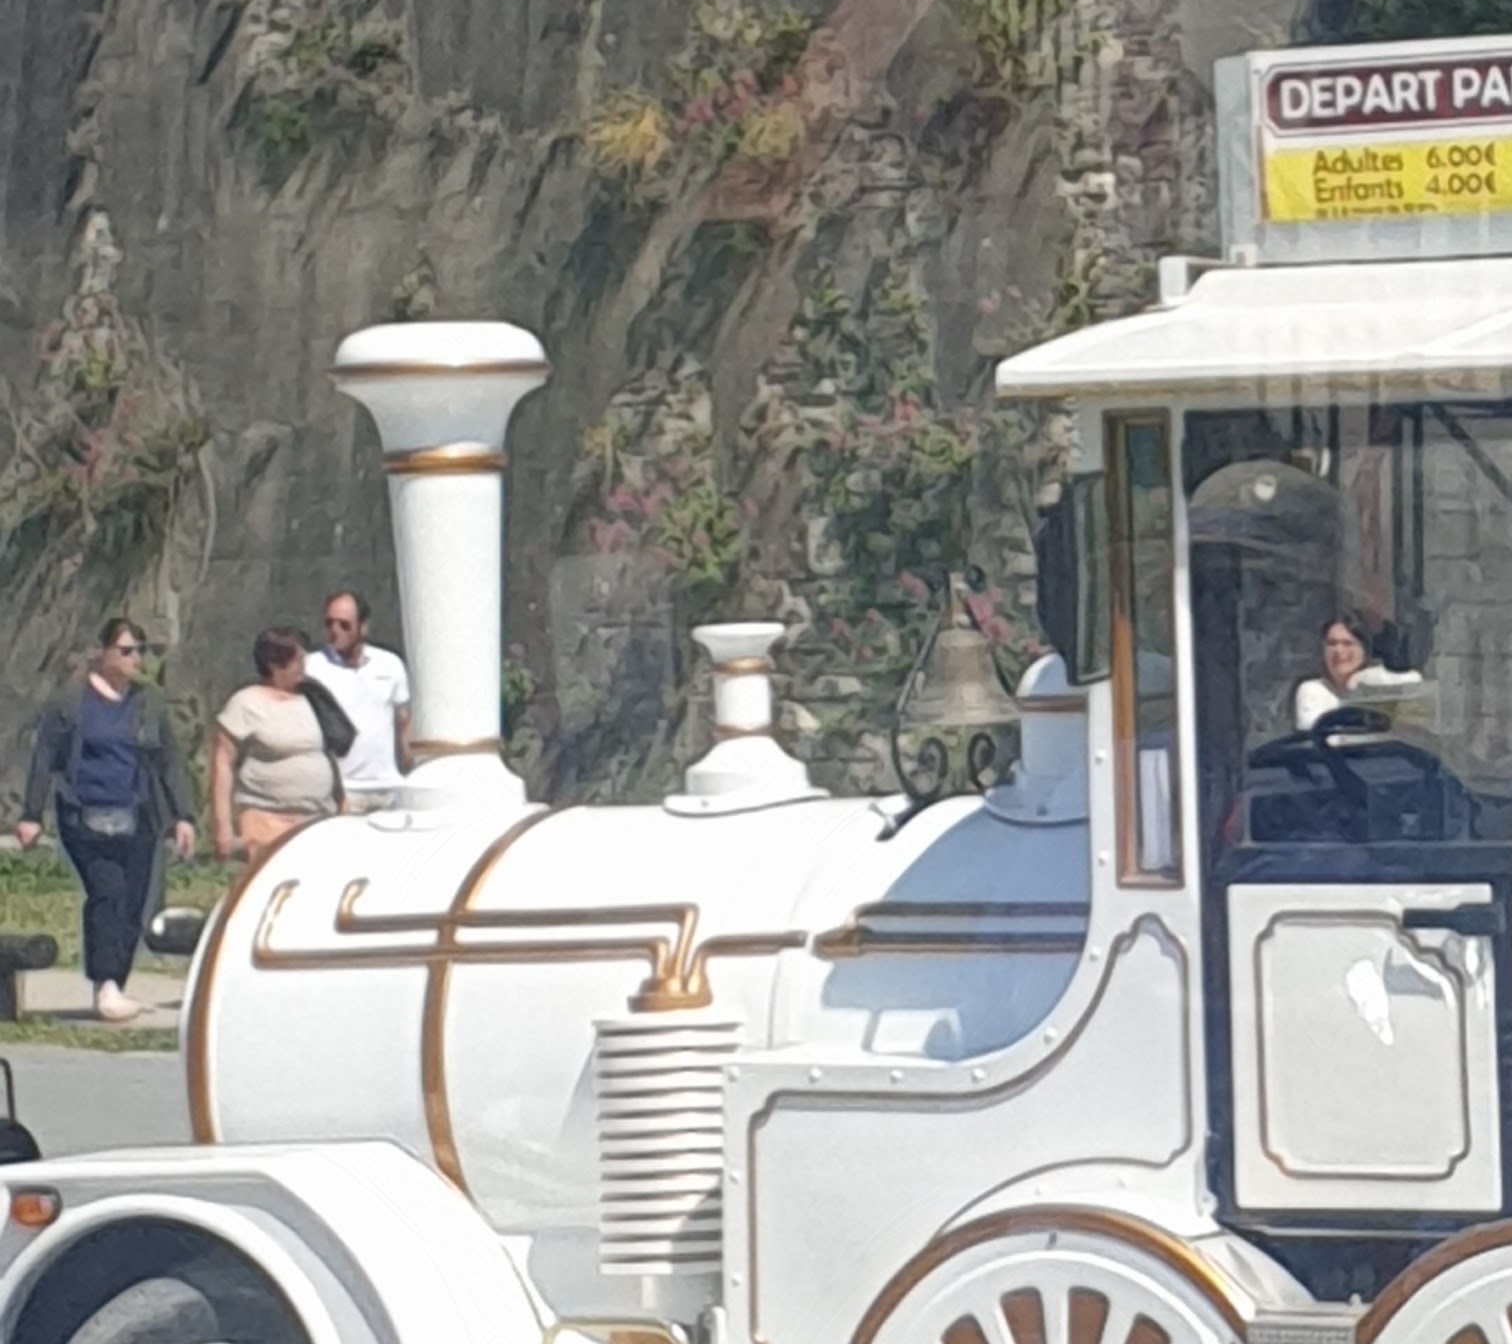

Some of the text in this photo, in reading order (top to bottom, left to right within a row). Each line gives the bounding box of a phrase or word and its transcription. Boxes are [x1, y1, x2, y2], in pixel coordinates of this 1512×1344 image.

[1280, 69, 1442, 120] DEPART
[1313, 148, 1403, 176] Adultes
[1313, 176, 1404, 204] Enfants
